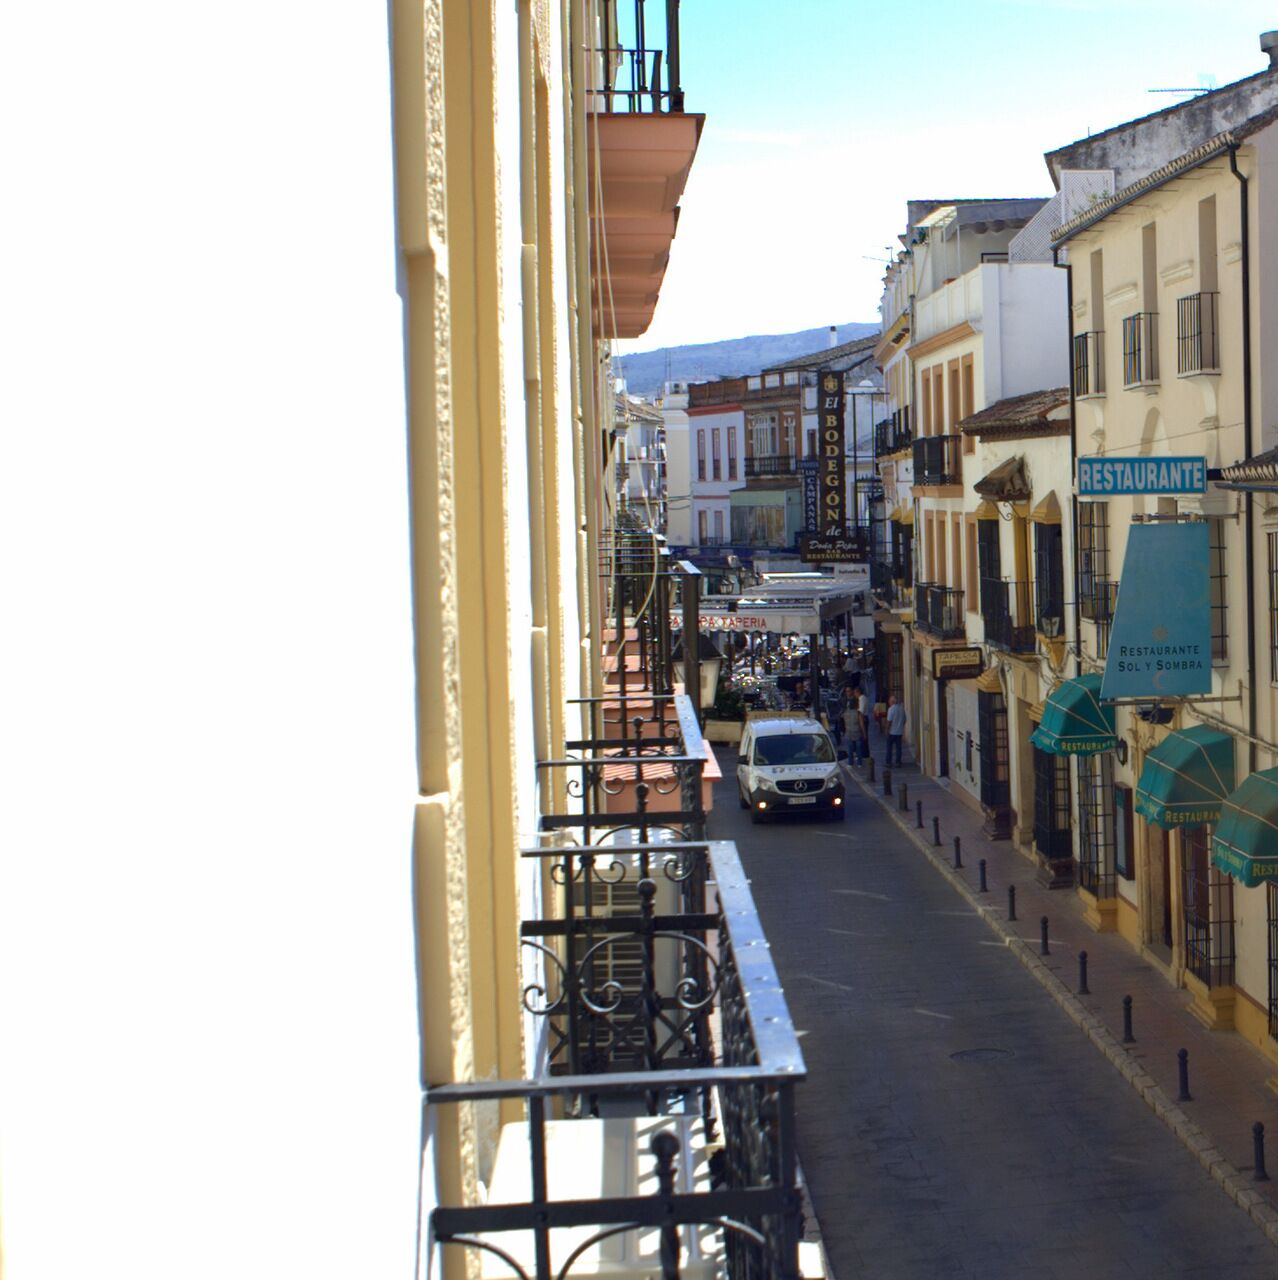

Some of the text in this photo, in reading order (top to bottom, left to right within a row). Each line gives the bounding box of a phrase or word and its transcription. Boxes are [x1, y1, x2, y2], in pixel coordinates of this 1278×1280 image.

[824, 397, 839, 409] El
[824, 415, 841, 521] BODEGÓN
[1080, 462, 1203, 491] RESTAURANTE
[826, 526, 842, 537] de
[720, 616, 767, 629] TAPERIA
[1120, 645, 1200, 657] RESTAURANTE
[1118, 660, 1203, 672] SOL Y SOMBRA
